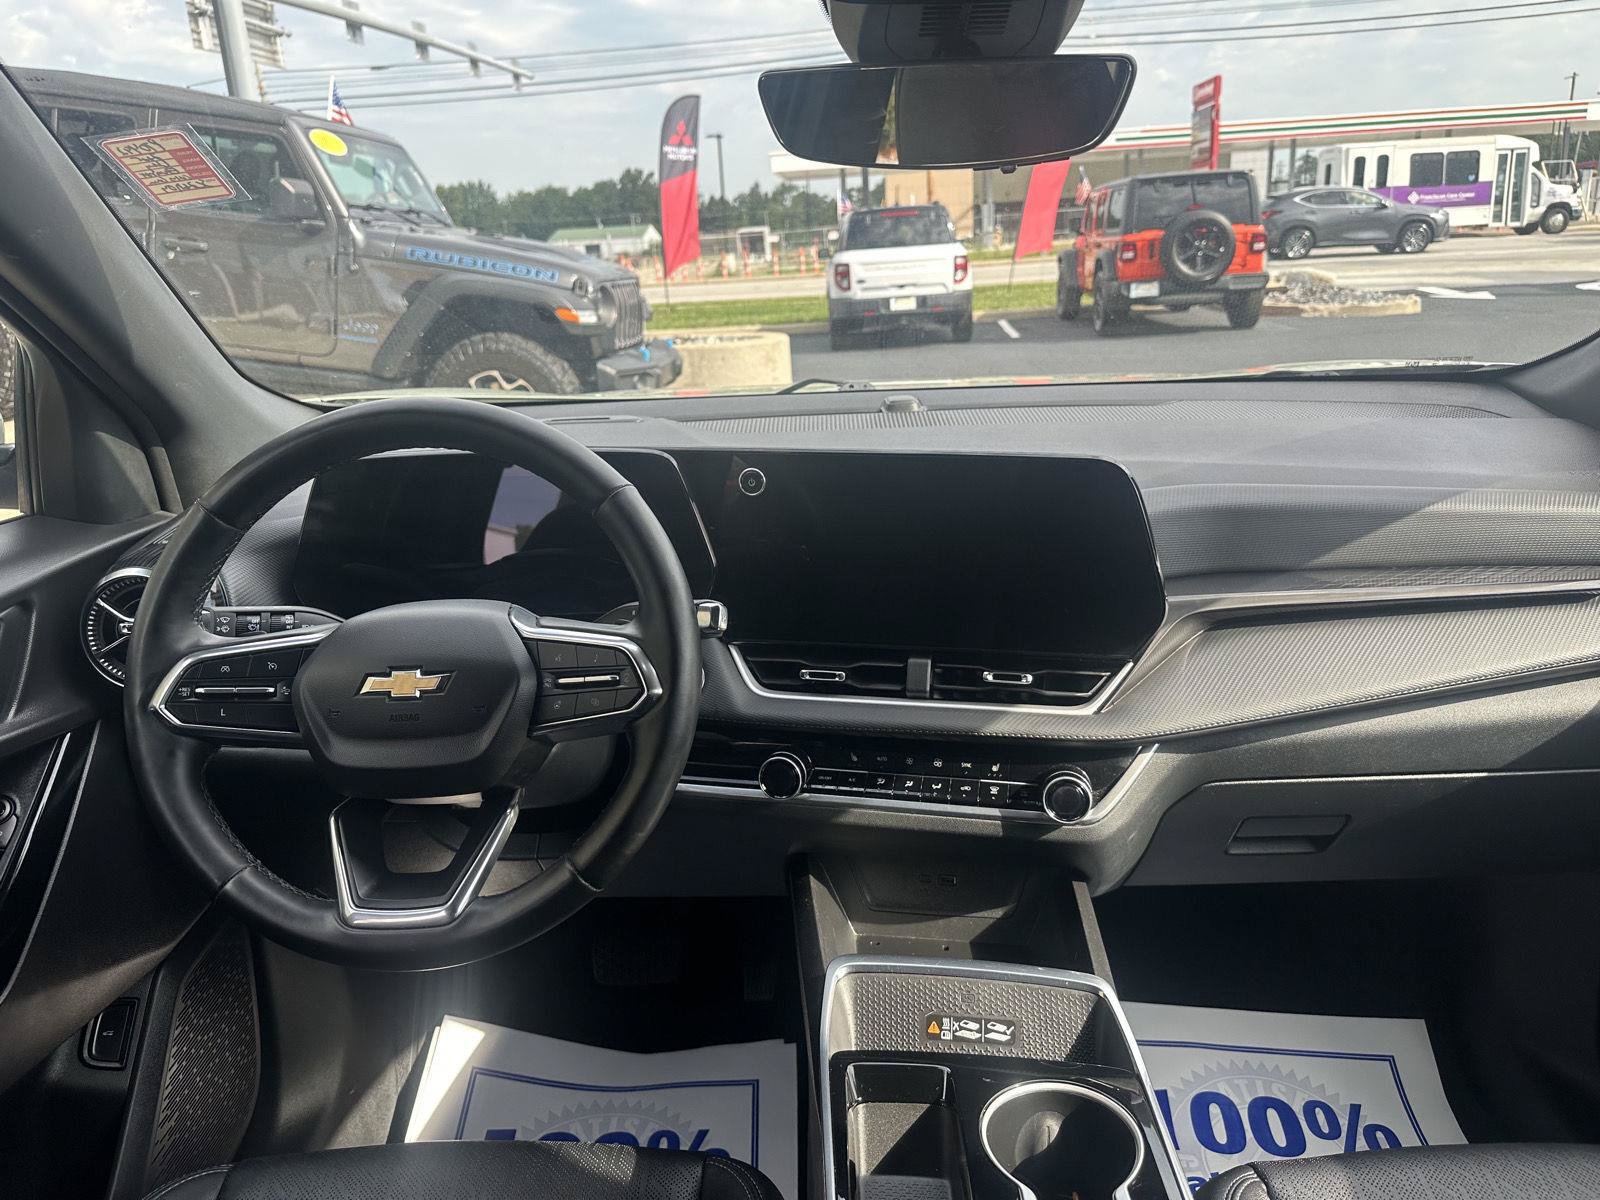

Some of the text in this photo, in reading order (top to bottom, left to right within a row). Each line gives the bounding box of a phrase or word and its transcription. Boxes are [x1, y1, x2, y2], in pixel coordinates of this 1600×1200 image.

[406, 246, 560, 283] RUBICON
[220, 708, 226, 717] L
[388, 713, 420, 722] AIRBAG
